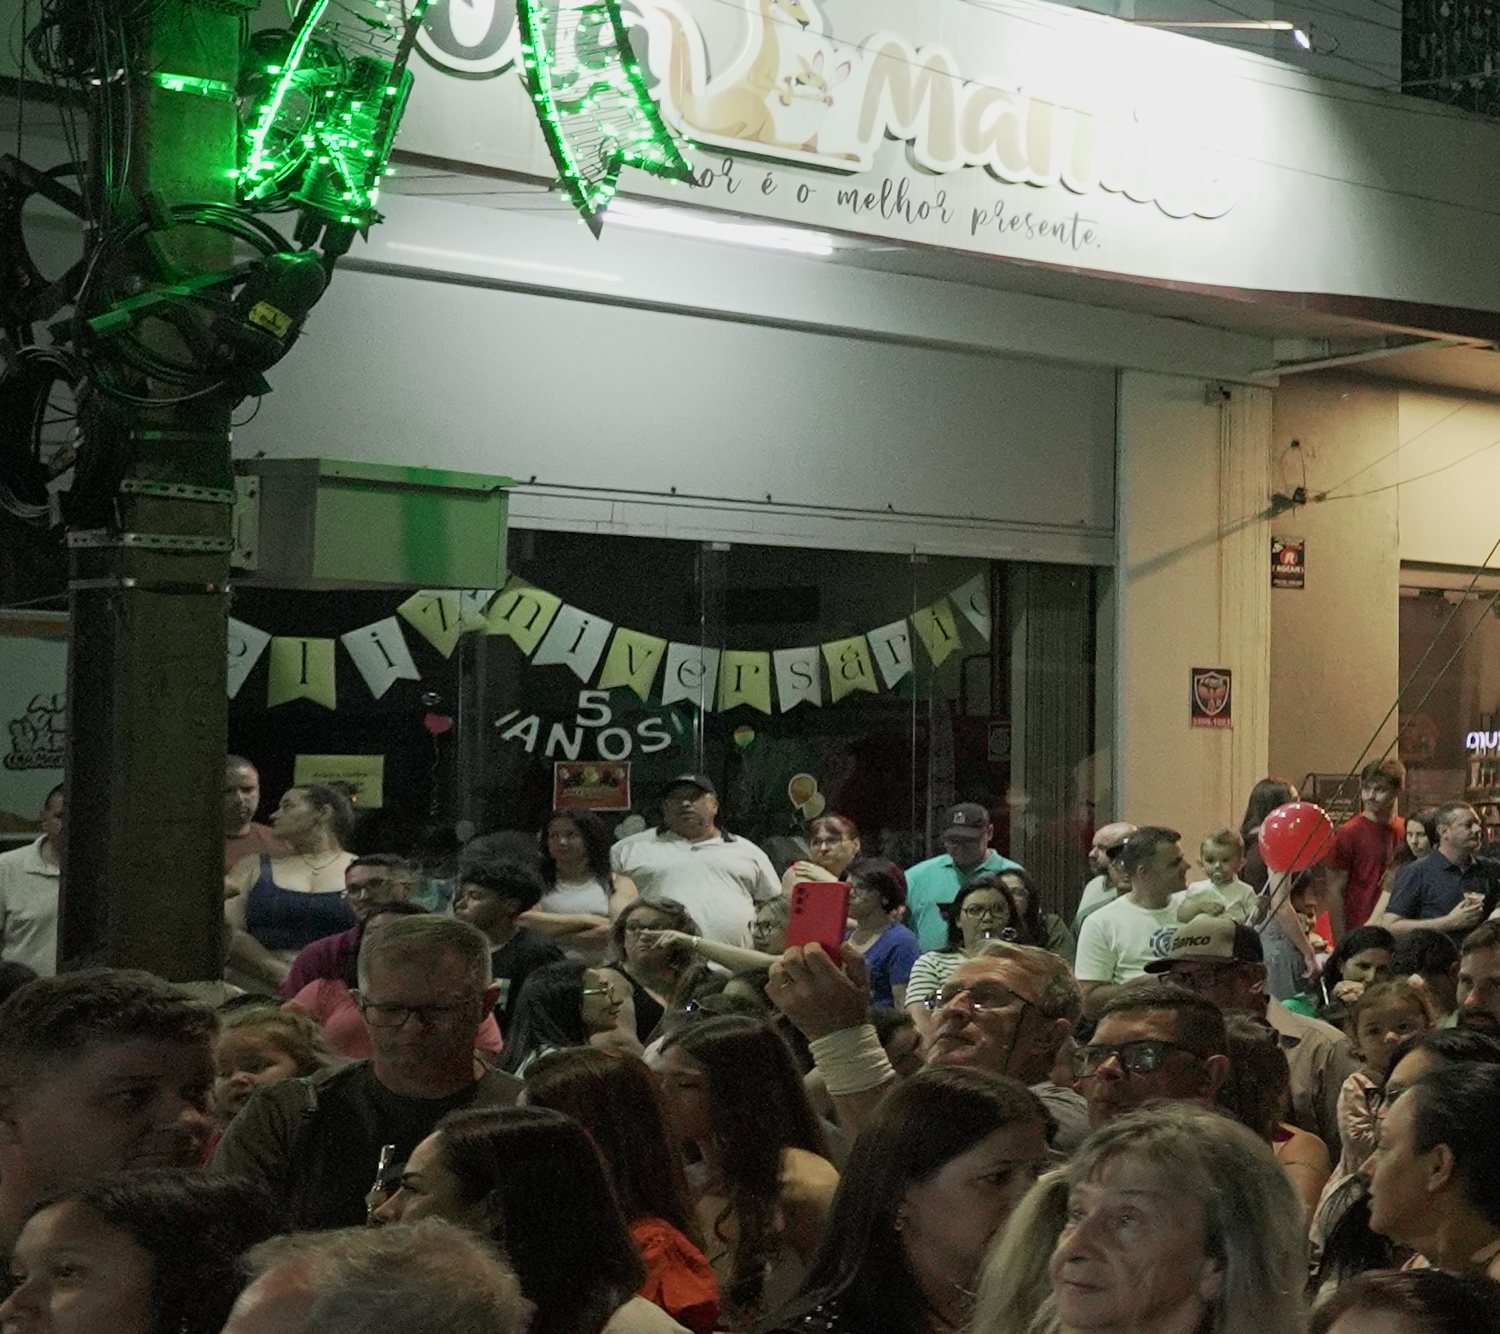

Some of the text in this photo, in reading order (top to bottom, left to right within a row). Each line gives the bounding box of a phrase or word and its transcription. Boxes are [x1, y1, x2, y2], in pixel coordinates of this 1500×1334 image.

[836, 176, 955, 225] melhor
[577, 690, 612, 727] 5
[502, 713, 672, 761] ANOS
